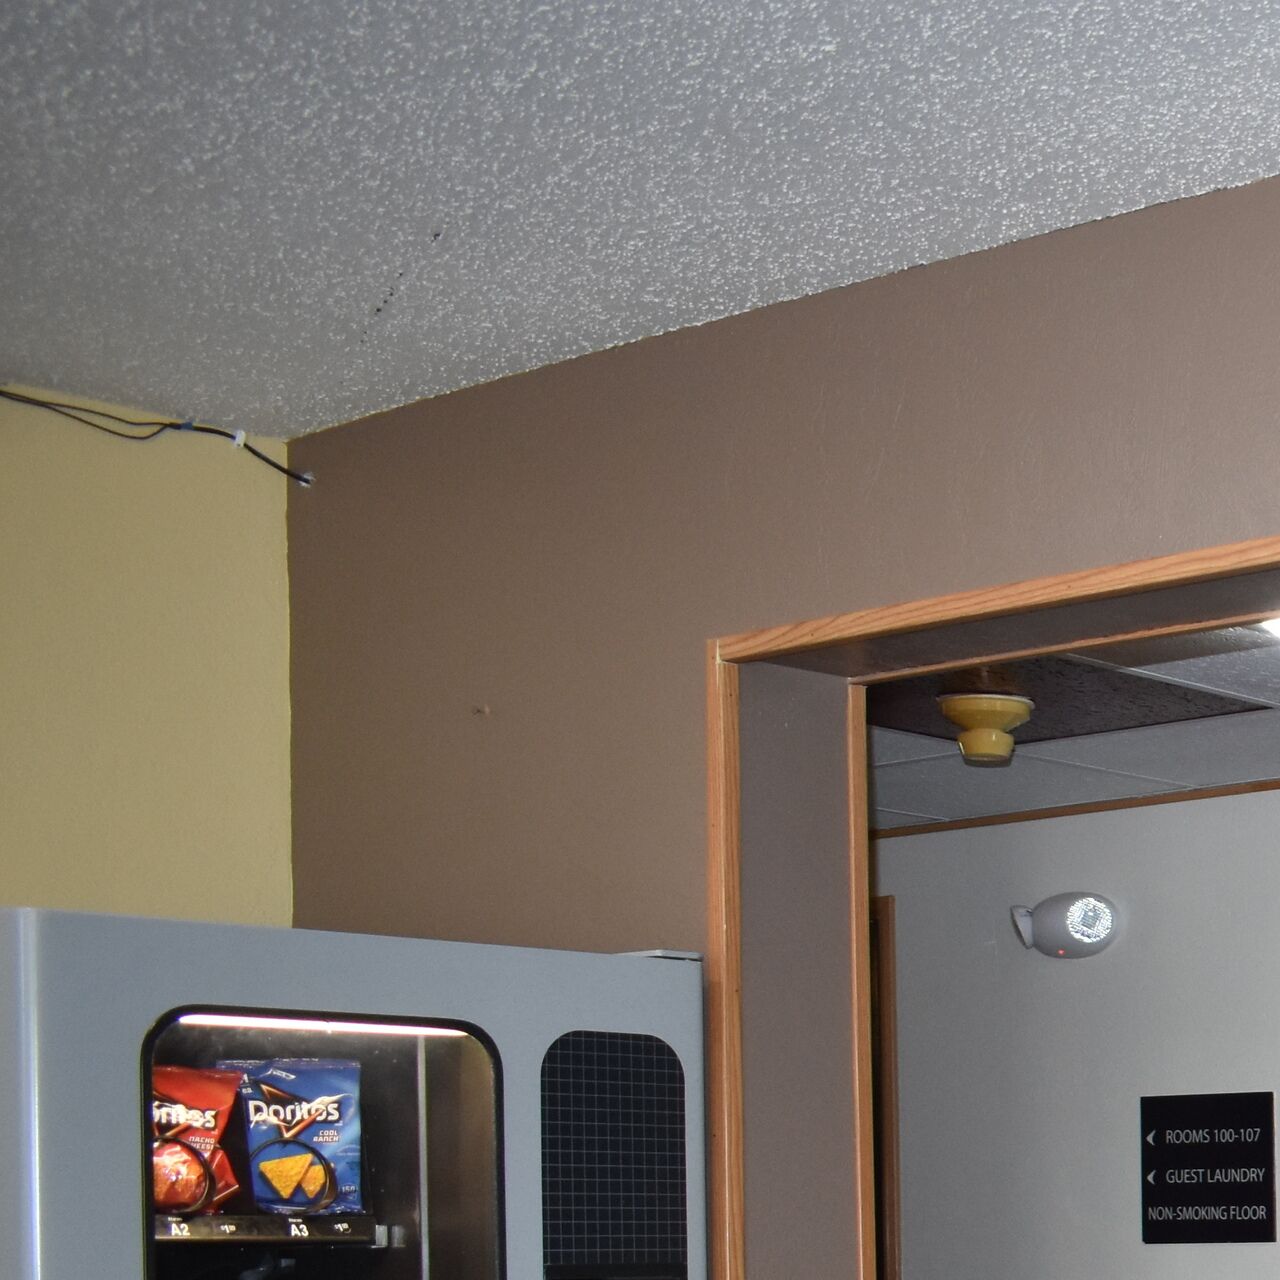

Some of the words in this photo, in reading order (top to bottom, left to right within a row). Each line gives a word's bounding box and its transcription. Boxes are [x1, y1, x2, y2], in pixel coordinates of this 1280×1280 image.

[250, 1099, 340, 1122] Doritos
[189, 1135, 215, 1144] NACHO
[1165, 1129, 1210, 1144] ROOMS
[1213, 1128, 1261, 1143] 100-107
[1165, 1168, 1205, 1183] GUEST
[1207, 1167, 1265, 1183] LAUNDRY
[1148, 1205, 1228, 1221] NON-SMOKING
[1230, 1205, 1267, 1220] FLOOR
[171, 1223, 190, 1235] A2
[291, 1223, 309, 1236] A3
